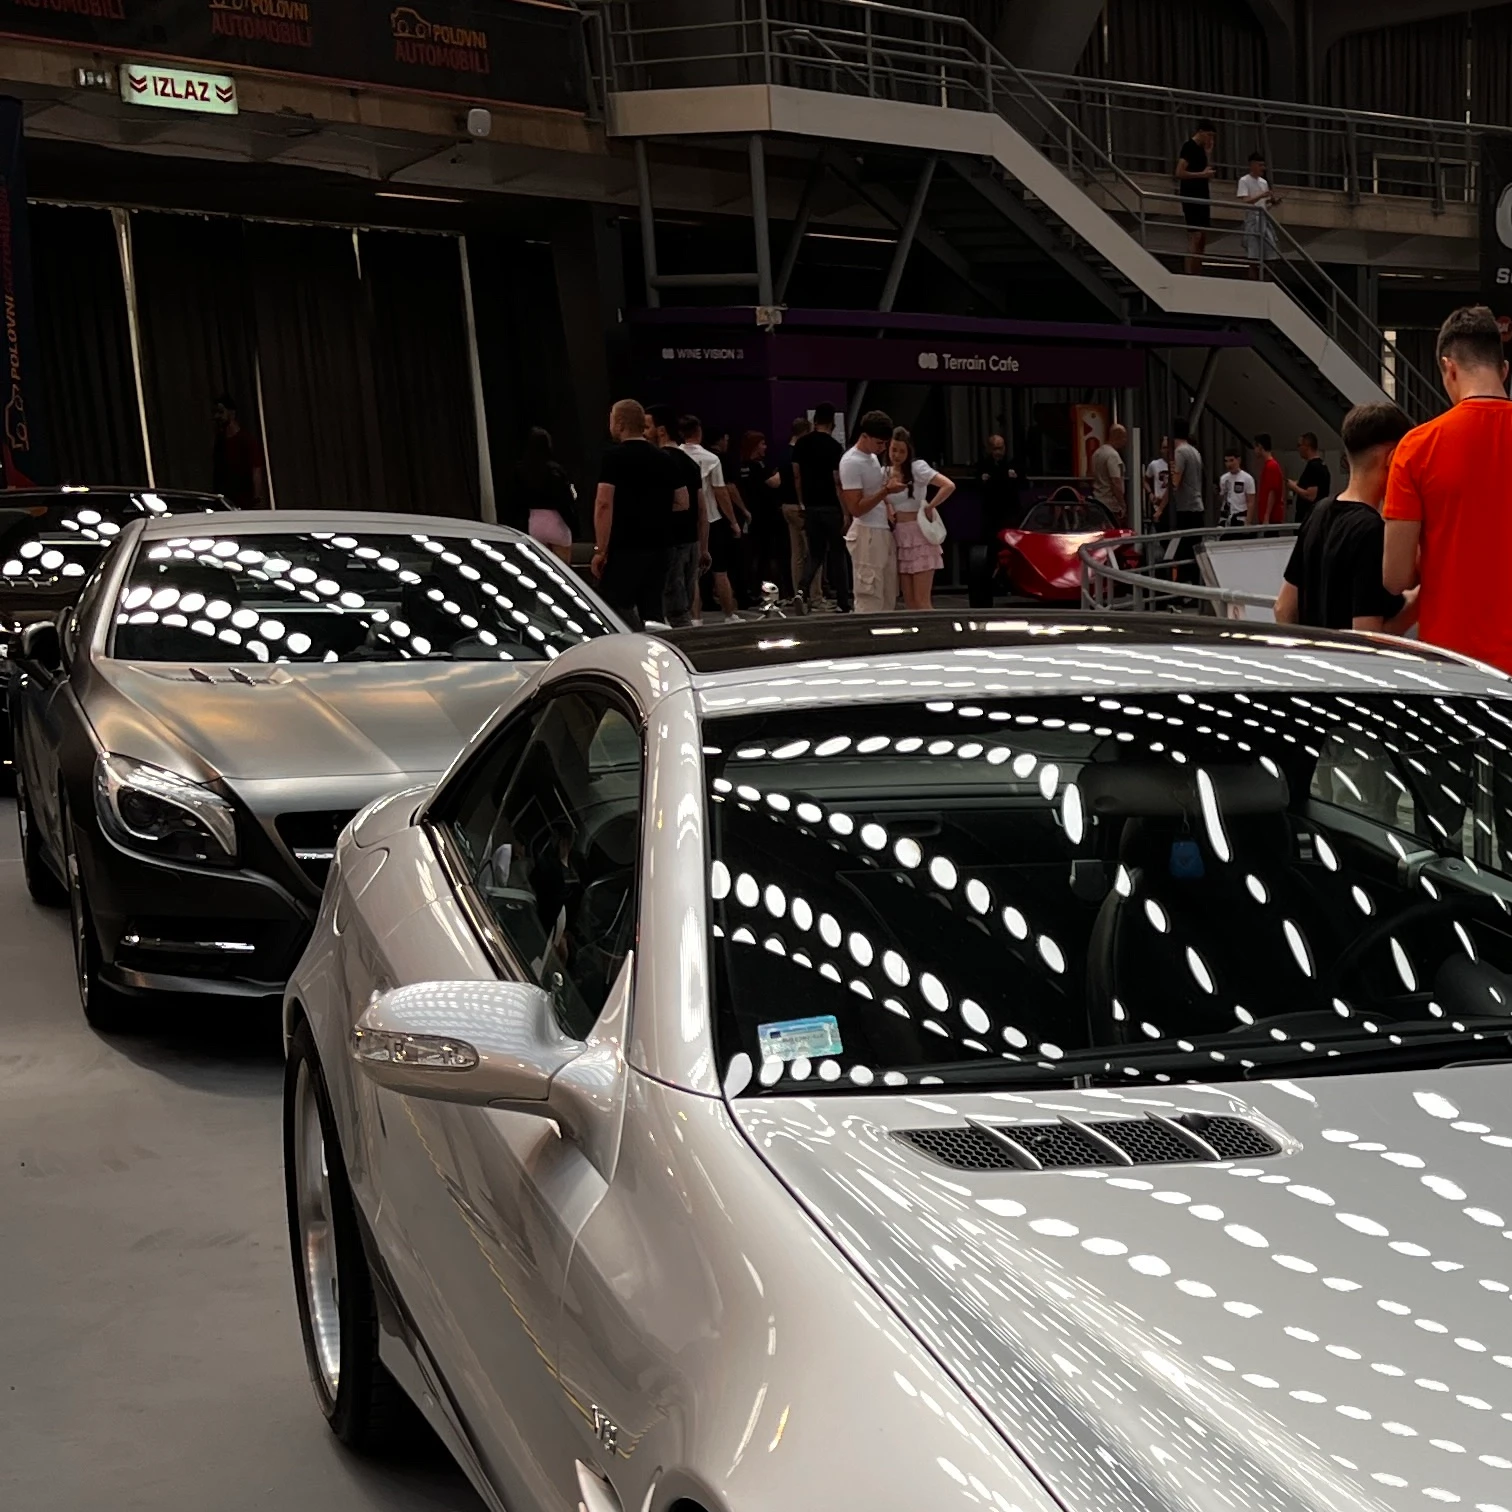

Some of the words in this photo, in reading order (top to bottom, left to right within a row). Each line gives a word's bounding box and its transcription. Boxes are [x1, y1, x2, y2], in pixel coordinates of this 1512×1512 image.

[13, 0, 126, 20] OMOBILI
[431, 24, 488, 49] POLOVNI
[395, 40, 490, 74] AUTOMOBILI
[152, 76, 211, 102] IZLAZ
[941, 353, 986, 371] Terrain
[989, 355, 1020, 372] Cafe
